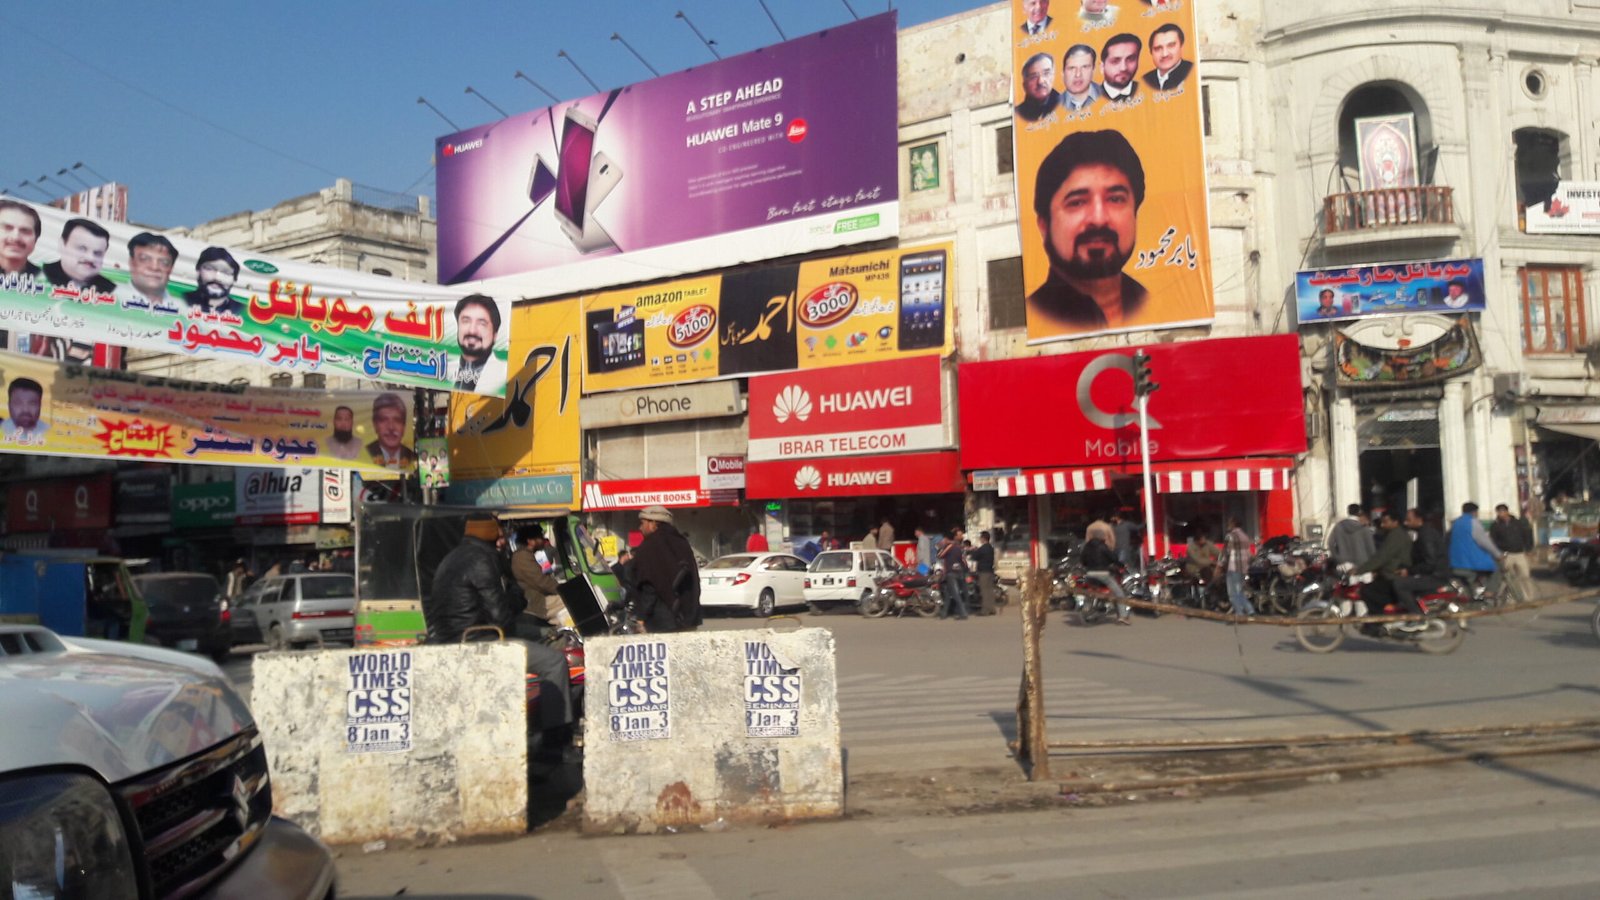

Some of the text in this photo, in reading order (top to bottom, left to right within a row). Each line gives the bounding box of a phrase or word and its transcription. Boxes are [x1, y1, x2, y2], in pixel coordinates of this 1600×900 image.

[686, 78, 783, 115] A STEP AHEAD
[686, 112, 784, 148] HUAWEI Mate 9
[454, 139, 483, 155] HUAWEI
[836, 222, 858, 232] FREE
[1135, 226, 1196, 269] بابر محمود
[829, 261, 890, 278] Matsunichi
[636, 288, 708, 308] amazon TABLET
[809, 293, 849, 321] 3000
[248, 279, 444, 344] الف موبائل
[739, 290, 796, 346] احمد
[167, 320, 265, 357] محمود
[676, 315, 709, 342] 5100
[269, 335, 322, 370] بابر
[362, 342, 448, 382] افتتاح
[480, 334, 572, 435] احمد
[1076, 352, 1163, 430] Q
[820, 386, 912, 414] HUAWEI
[109, 428, 166, 452] افتتاح
[186, 425, 254, 456] سنٹر
[261, 436, 317, 461] عجوہ
[779, 433, 906, 456] IBRAR TELECOM
[1085, 438, 1160, 458] Mobie
[522, 482, 546, 496] LAW
[828, 470, 893, 486] HUAWEI
[618, 492, 693, 504] MULTI-LINE BOOKS
[349, 652, 411, 673] WORLD
[611, 661, 665, 679] TIMES
[350, 672, 408, 689] TIMES
[609, 678, 668, 707] CSS
[744, 676, 799, 703] CSS
[347, 688, 410, 718] CSS
[609, 704, 668, 714] SEMINAR
[624, 716, 650, 730] Jan
[659, 711, 668, 728] 3
[757, 713, 780, 727] Jan
[790, 711, 798, 727] 3
[363, 727, 389, 742] Jan
[400, 723, 409, 740] 3
